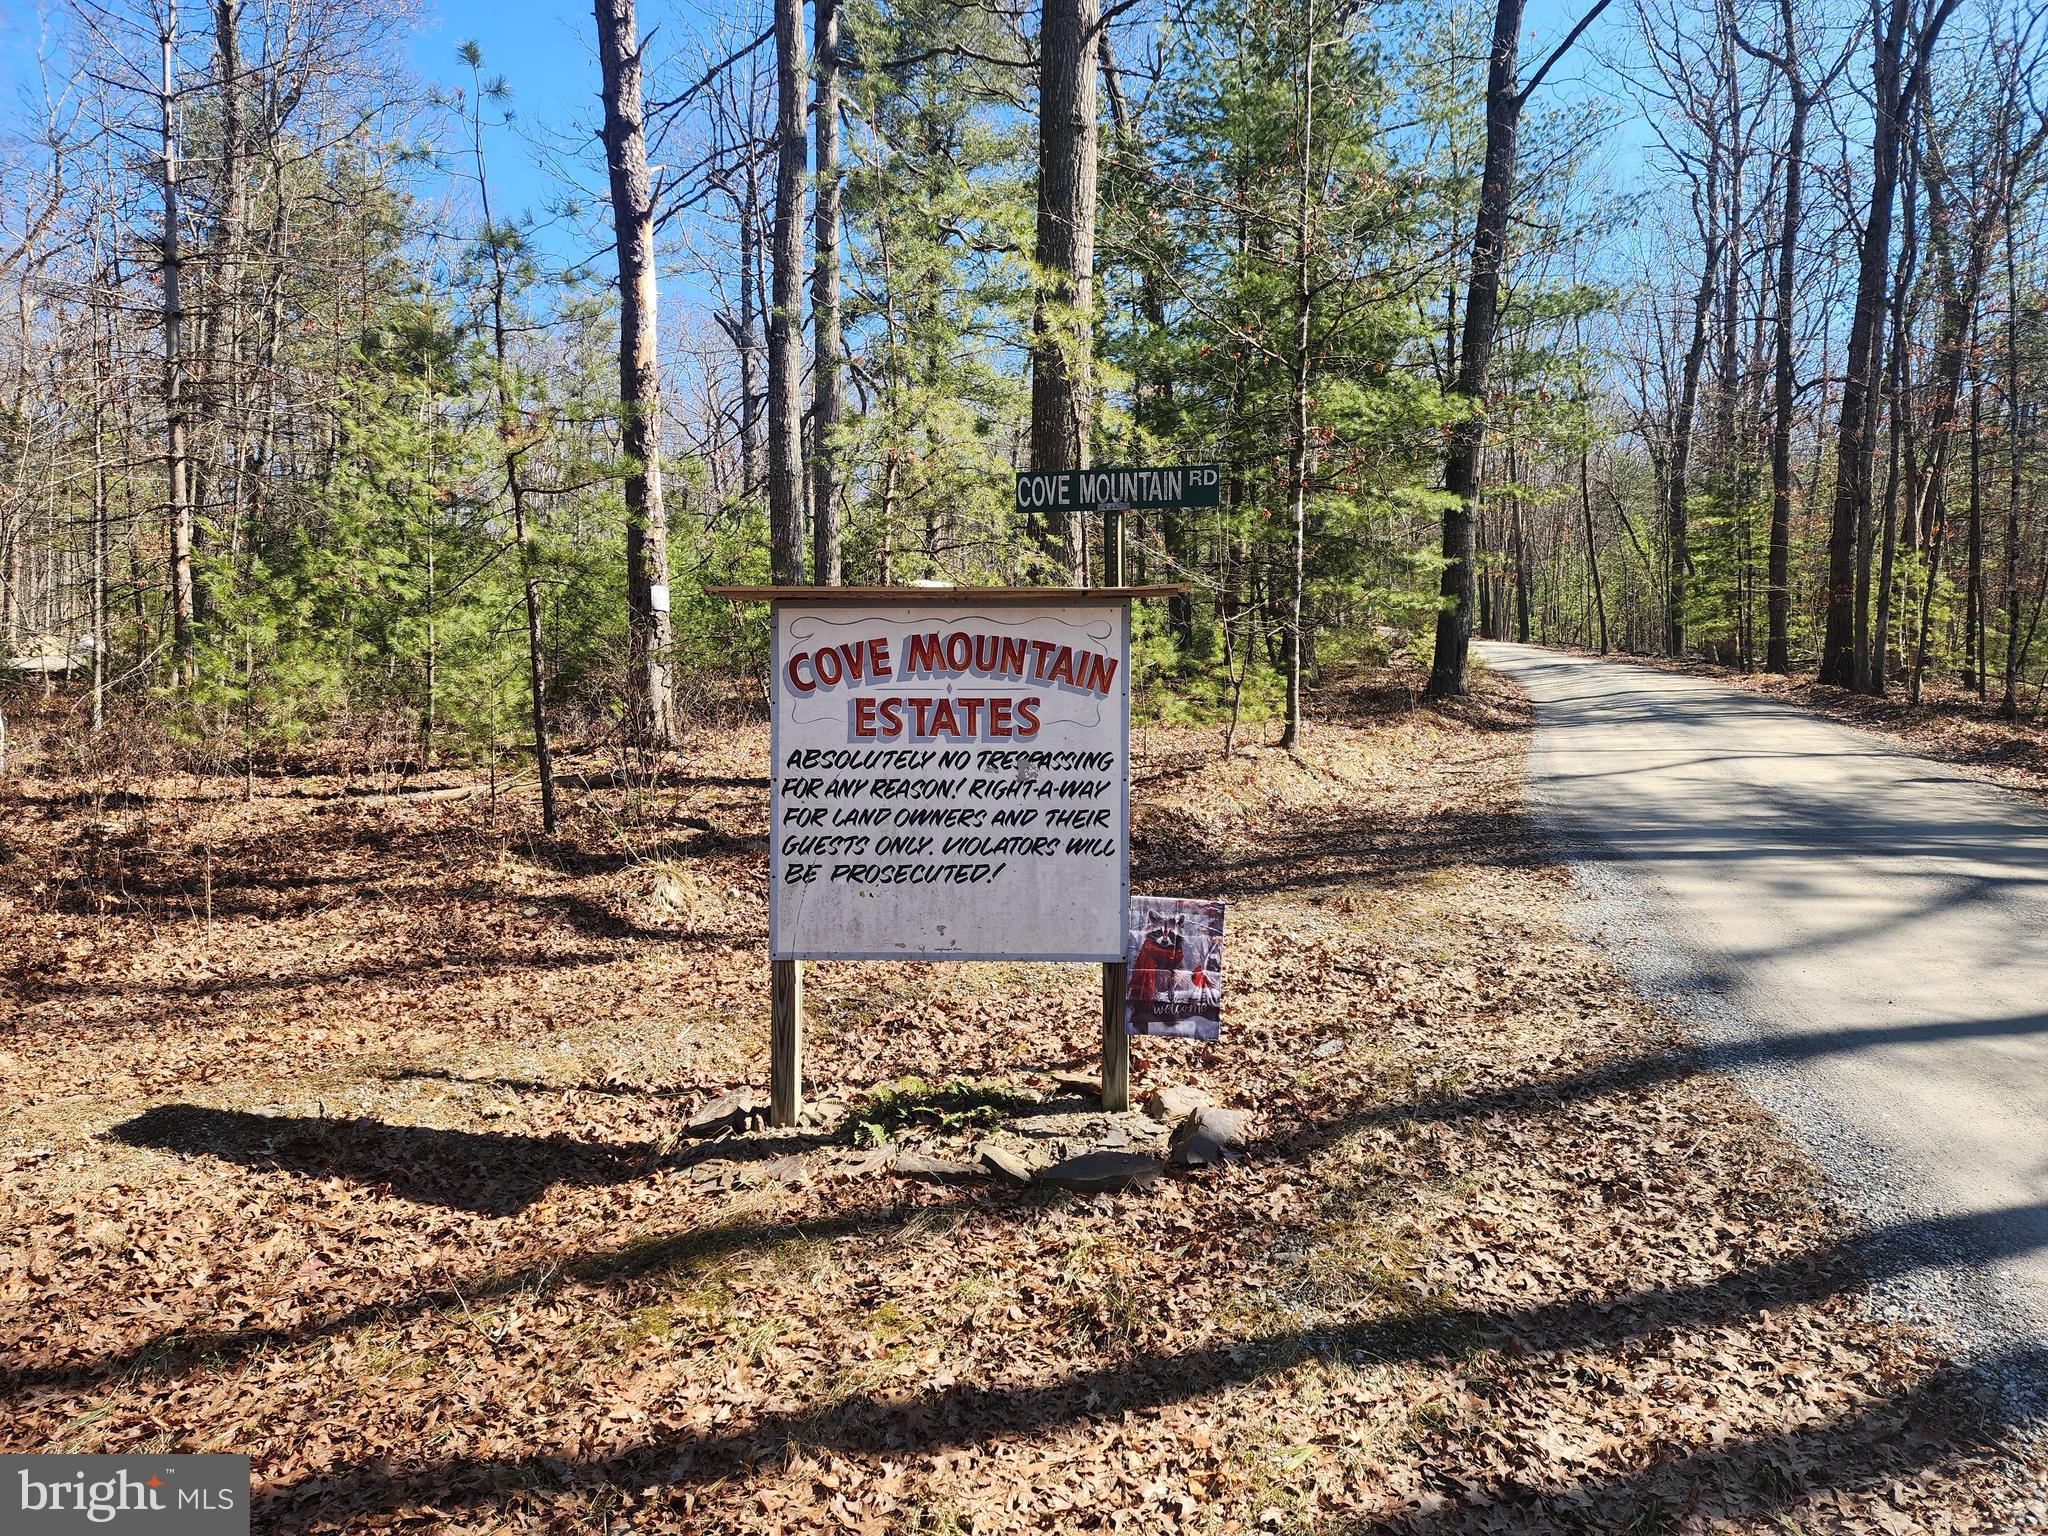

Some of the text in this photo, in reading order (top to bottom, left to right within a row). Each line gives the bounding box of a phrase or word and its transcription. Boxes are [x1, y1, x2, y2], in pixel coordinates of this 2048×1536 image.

[1018, 470, 1218, 507] COVE MOUNTAIN RD
[783, 631, 1118, 700] COVE MOUNTAIN
[848, 697, 1041, 744] ESTATES
[786, 749, 1114, 772] ABSOLUTELY NO TRESPASSING
[781, 777, 1111, 800] FOR ANY REASON! RIGHT-A-WAY
[783, 808, 1110, 829] FOR LAND OWNERS AND THEIR
[782, 835, 1115, 857] GUESTS ONLY. VIOLATORS WILL
[784, 862, 1006, 885] BE PROSECUTED!
[1153, 996, 1208, 1016] welcome
